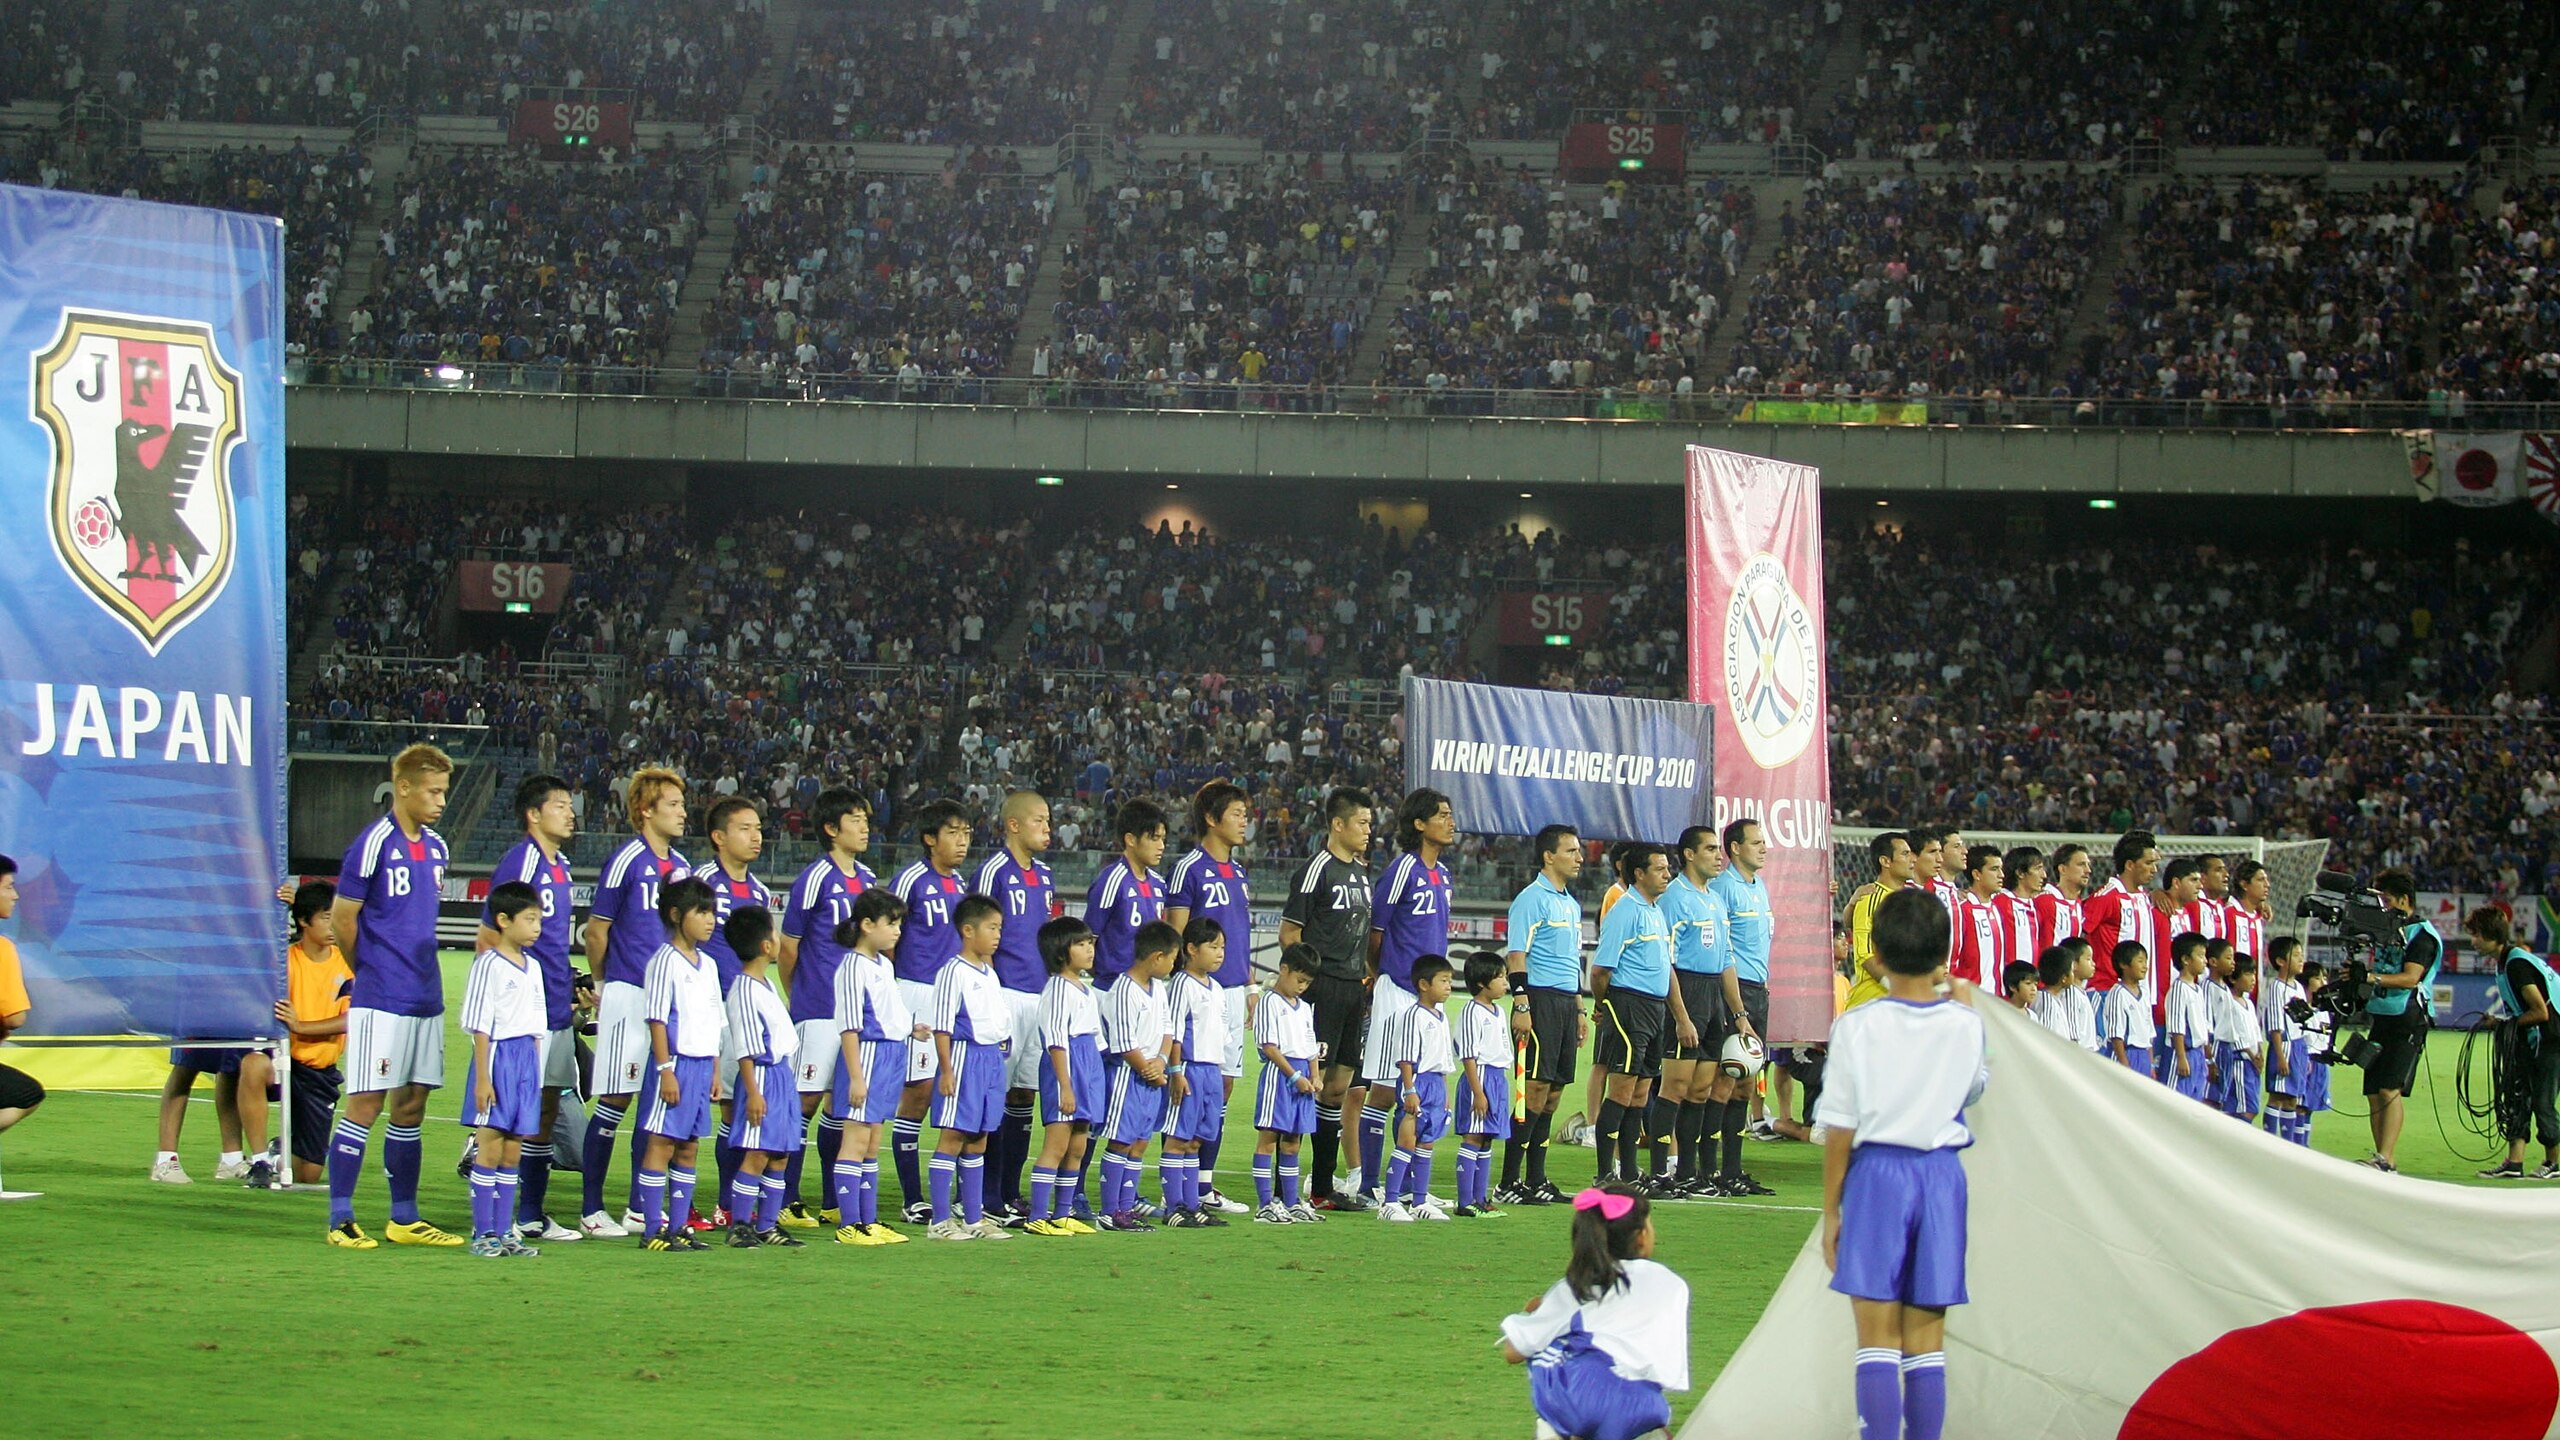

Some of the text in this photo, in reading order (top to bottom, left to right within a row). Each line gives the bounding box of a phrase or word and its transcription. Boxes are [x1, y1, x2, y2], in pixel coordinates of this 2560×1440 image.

[554, 104, 599, 132] S26
[1608, 126, 1654, 154] S25
[492, 563, 545, 599] S16
[1531, 594, 1583, 631] S15
[1791, 609, 1810, 638] DE
[1729, 586, 1747, 723] ASOCIACION
[1798, 645, 1816, 727] FUTBOL
[22, 683, 253, 766] JAPAN
[1431, 739, 1696, 789] KIRIN CHALLENGE CUP 2010
[387, 866, 411, 897] 18
[1203, 882, 1230, 908] 20
[1009, 889, 1026, 915] 19
[1332, 885, 1351, 909] 21
[1412, 890, 1437, 915] 22
[924, 898, 949, 927] 14
[1130, 901, 1142, 927] 6
[2122, 907, 2133, 926] 19
[1975, 918, 1991, 938] 15
[2238, 925, 2249, 942] 13
